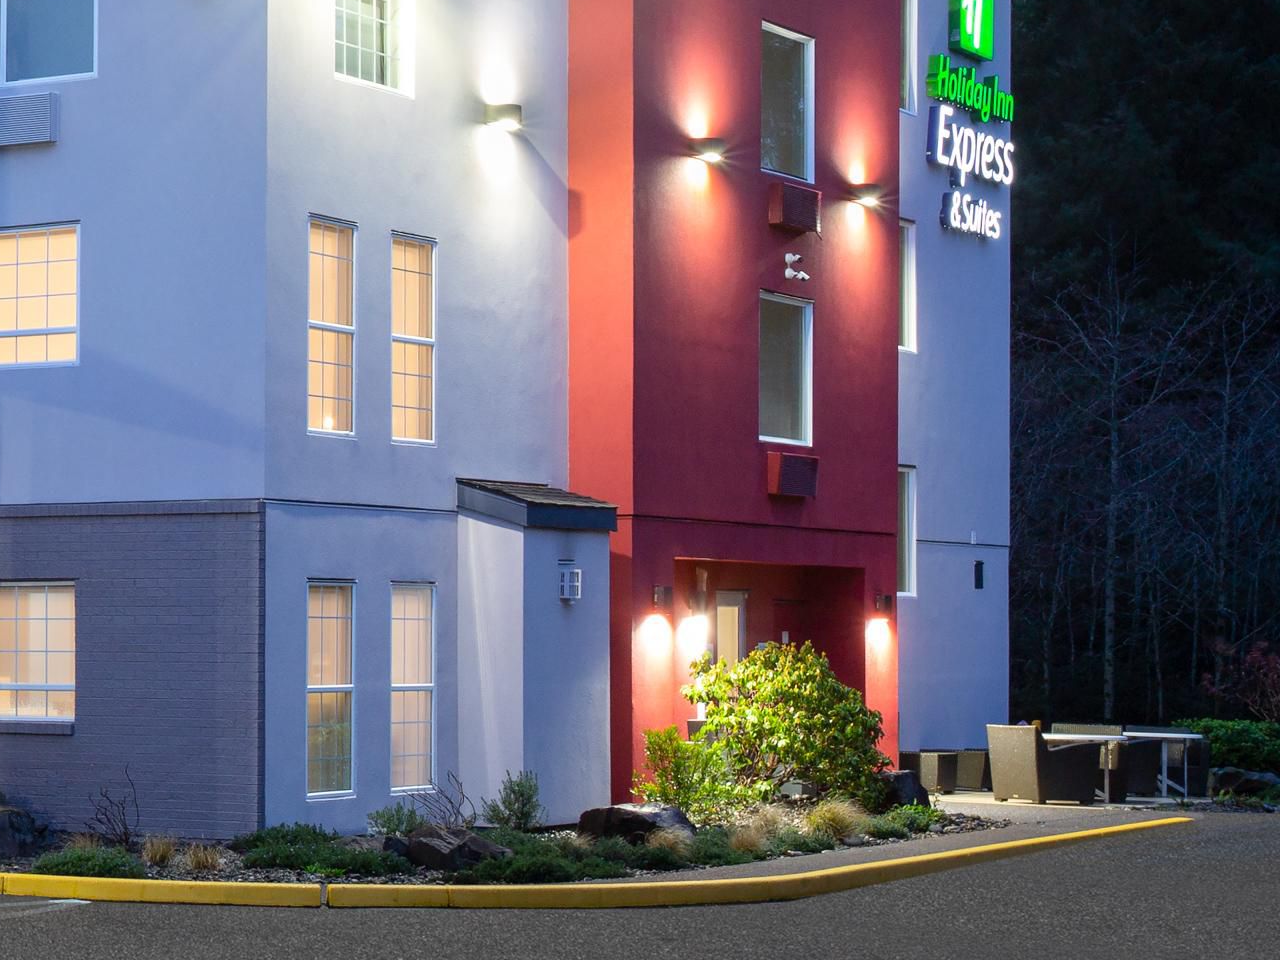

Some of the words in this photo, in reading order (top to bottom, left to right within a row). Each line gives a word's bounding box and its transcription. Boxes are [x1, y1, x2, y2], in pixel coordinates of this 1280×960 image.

[938, 54, 991, 122] Holiday
[993, 75, 1014, 122] Inn
[937, 104, 1015, 187] Express
